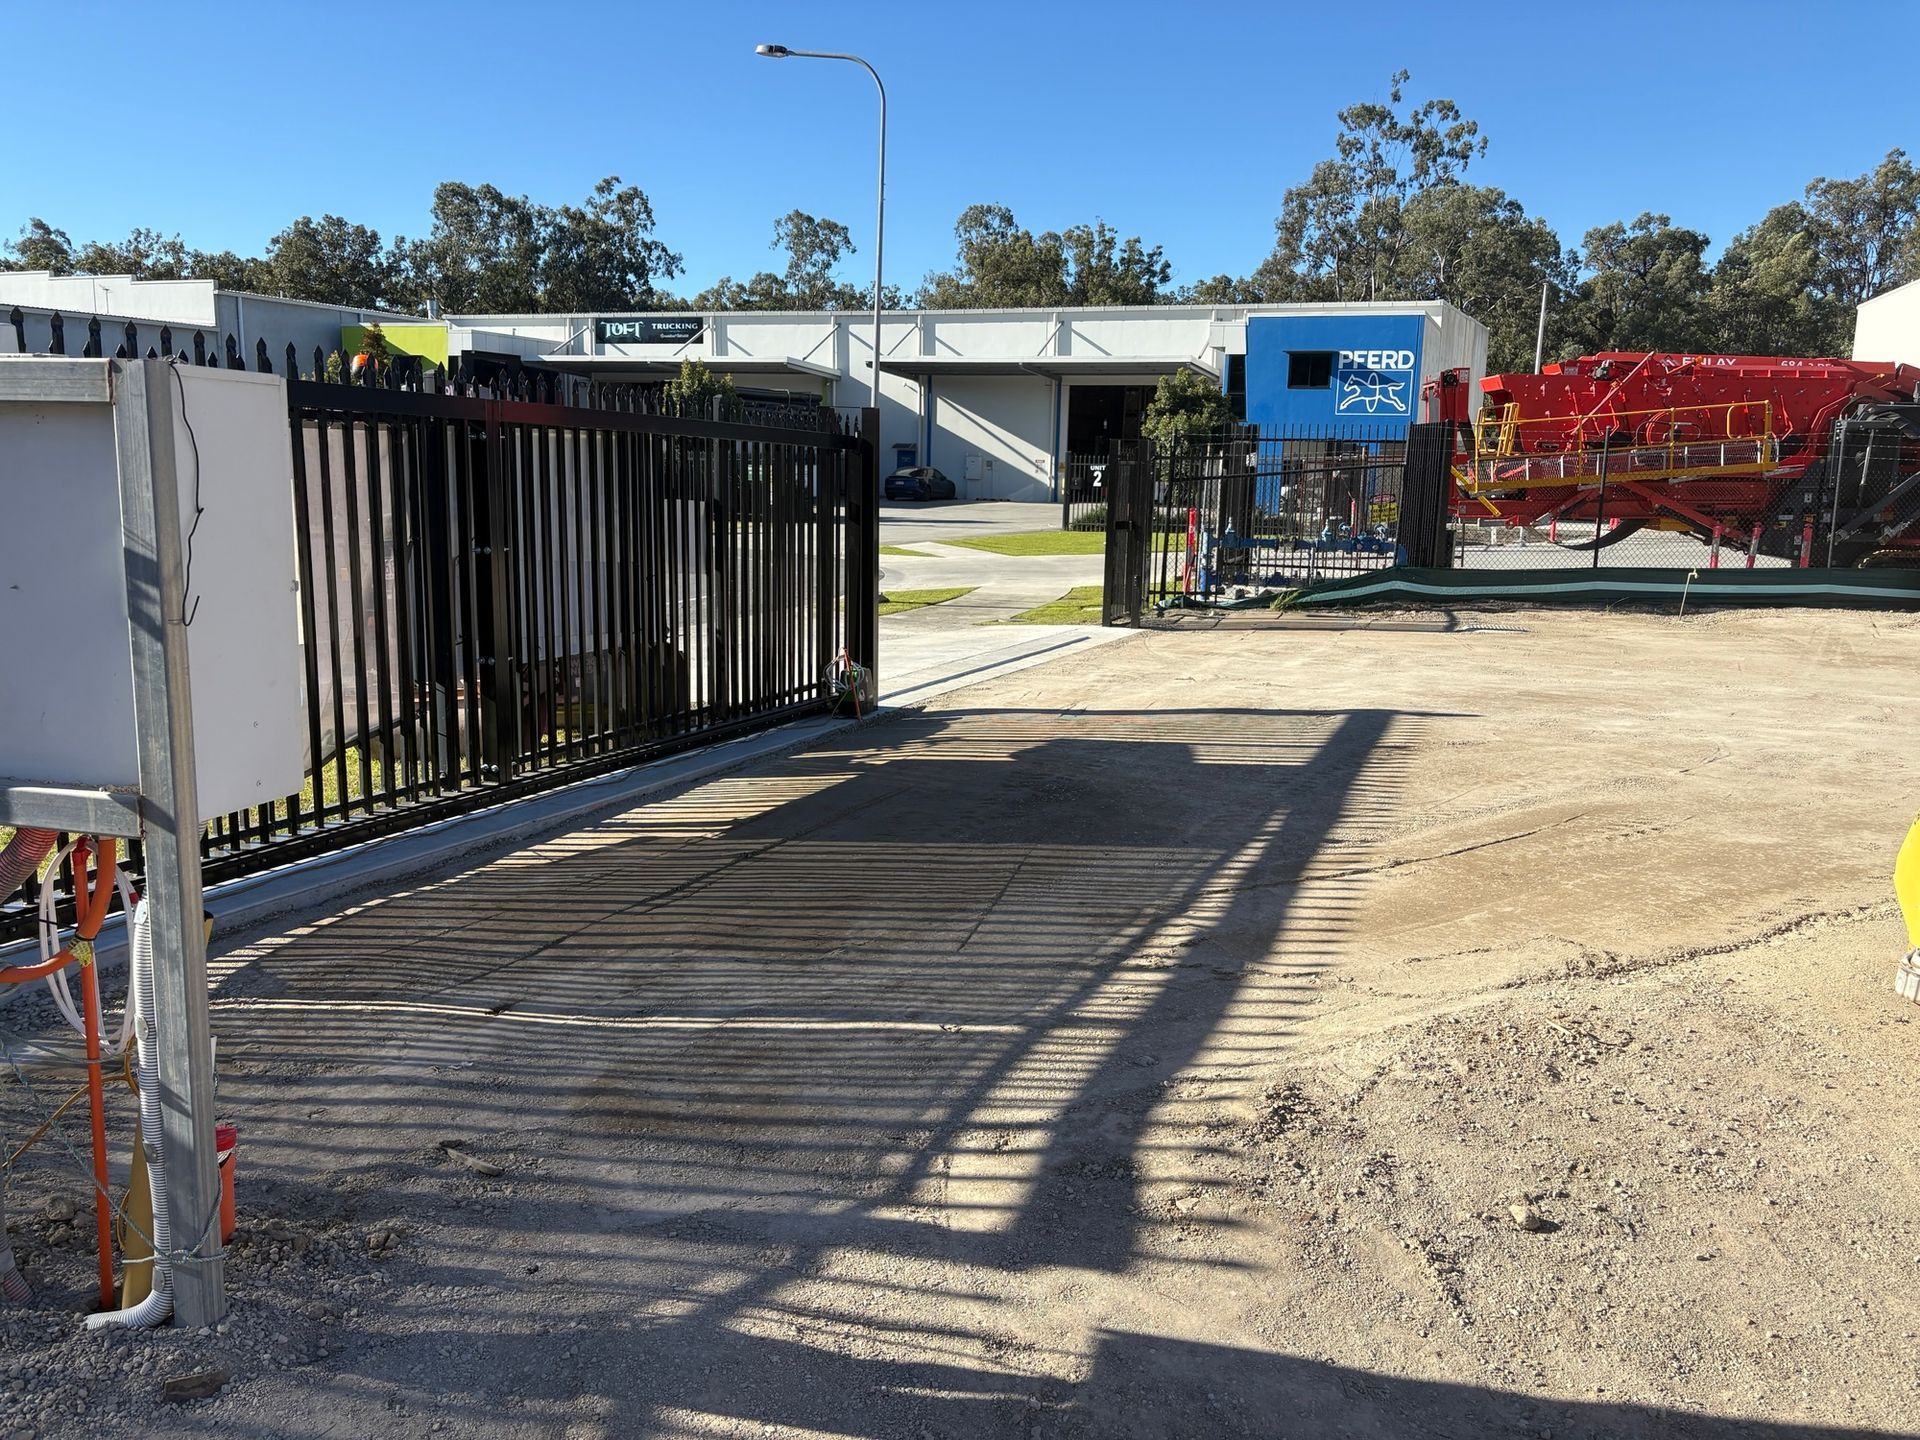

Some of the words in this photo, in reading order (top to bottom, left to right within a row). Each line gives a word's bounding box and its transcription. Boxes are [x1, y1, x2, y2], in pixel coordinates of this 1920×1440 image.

[600, 321, 645, 339] TOFT
[1338, 350, 1415, 369] PFERD
[1092, 471, 1102, 487] 2
